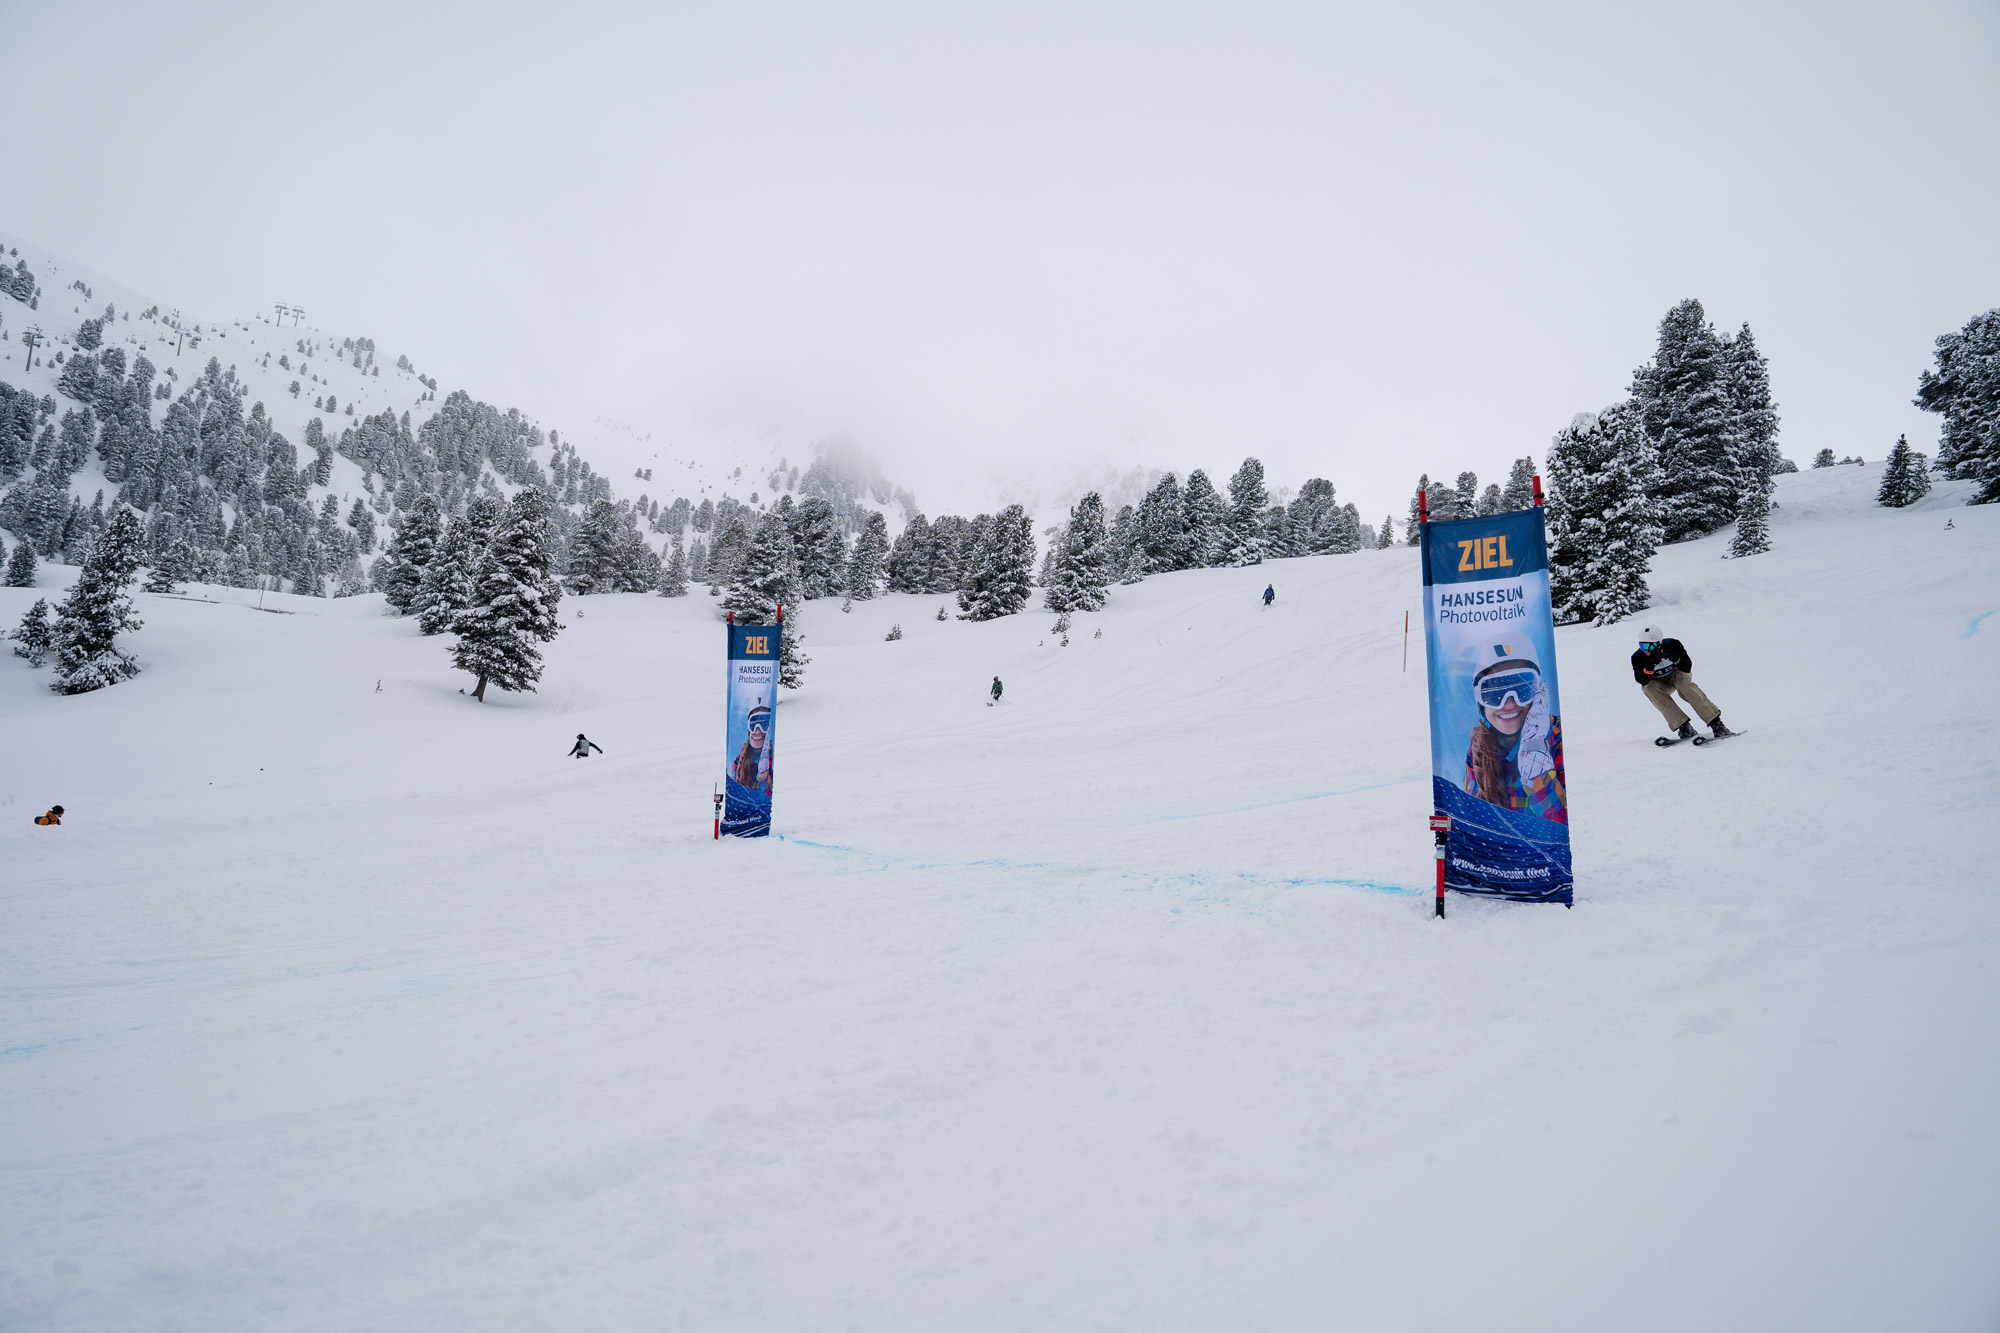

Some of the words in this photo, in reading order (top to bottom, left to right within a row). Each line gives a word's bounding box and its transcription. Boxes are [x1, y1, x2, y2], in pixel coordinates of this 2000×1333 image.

[1458, 535, 1513, 571] ZIEL
[1441, 585, 1523, 607] HANSESUN
[1440, 603, 1526, 623] Photovoltaik
[745, 636, 769, 654] ZIEL
[738, 675, 771, 684] Photovoltak
